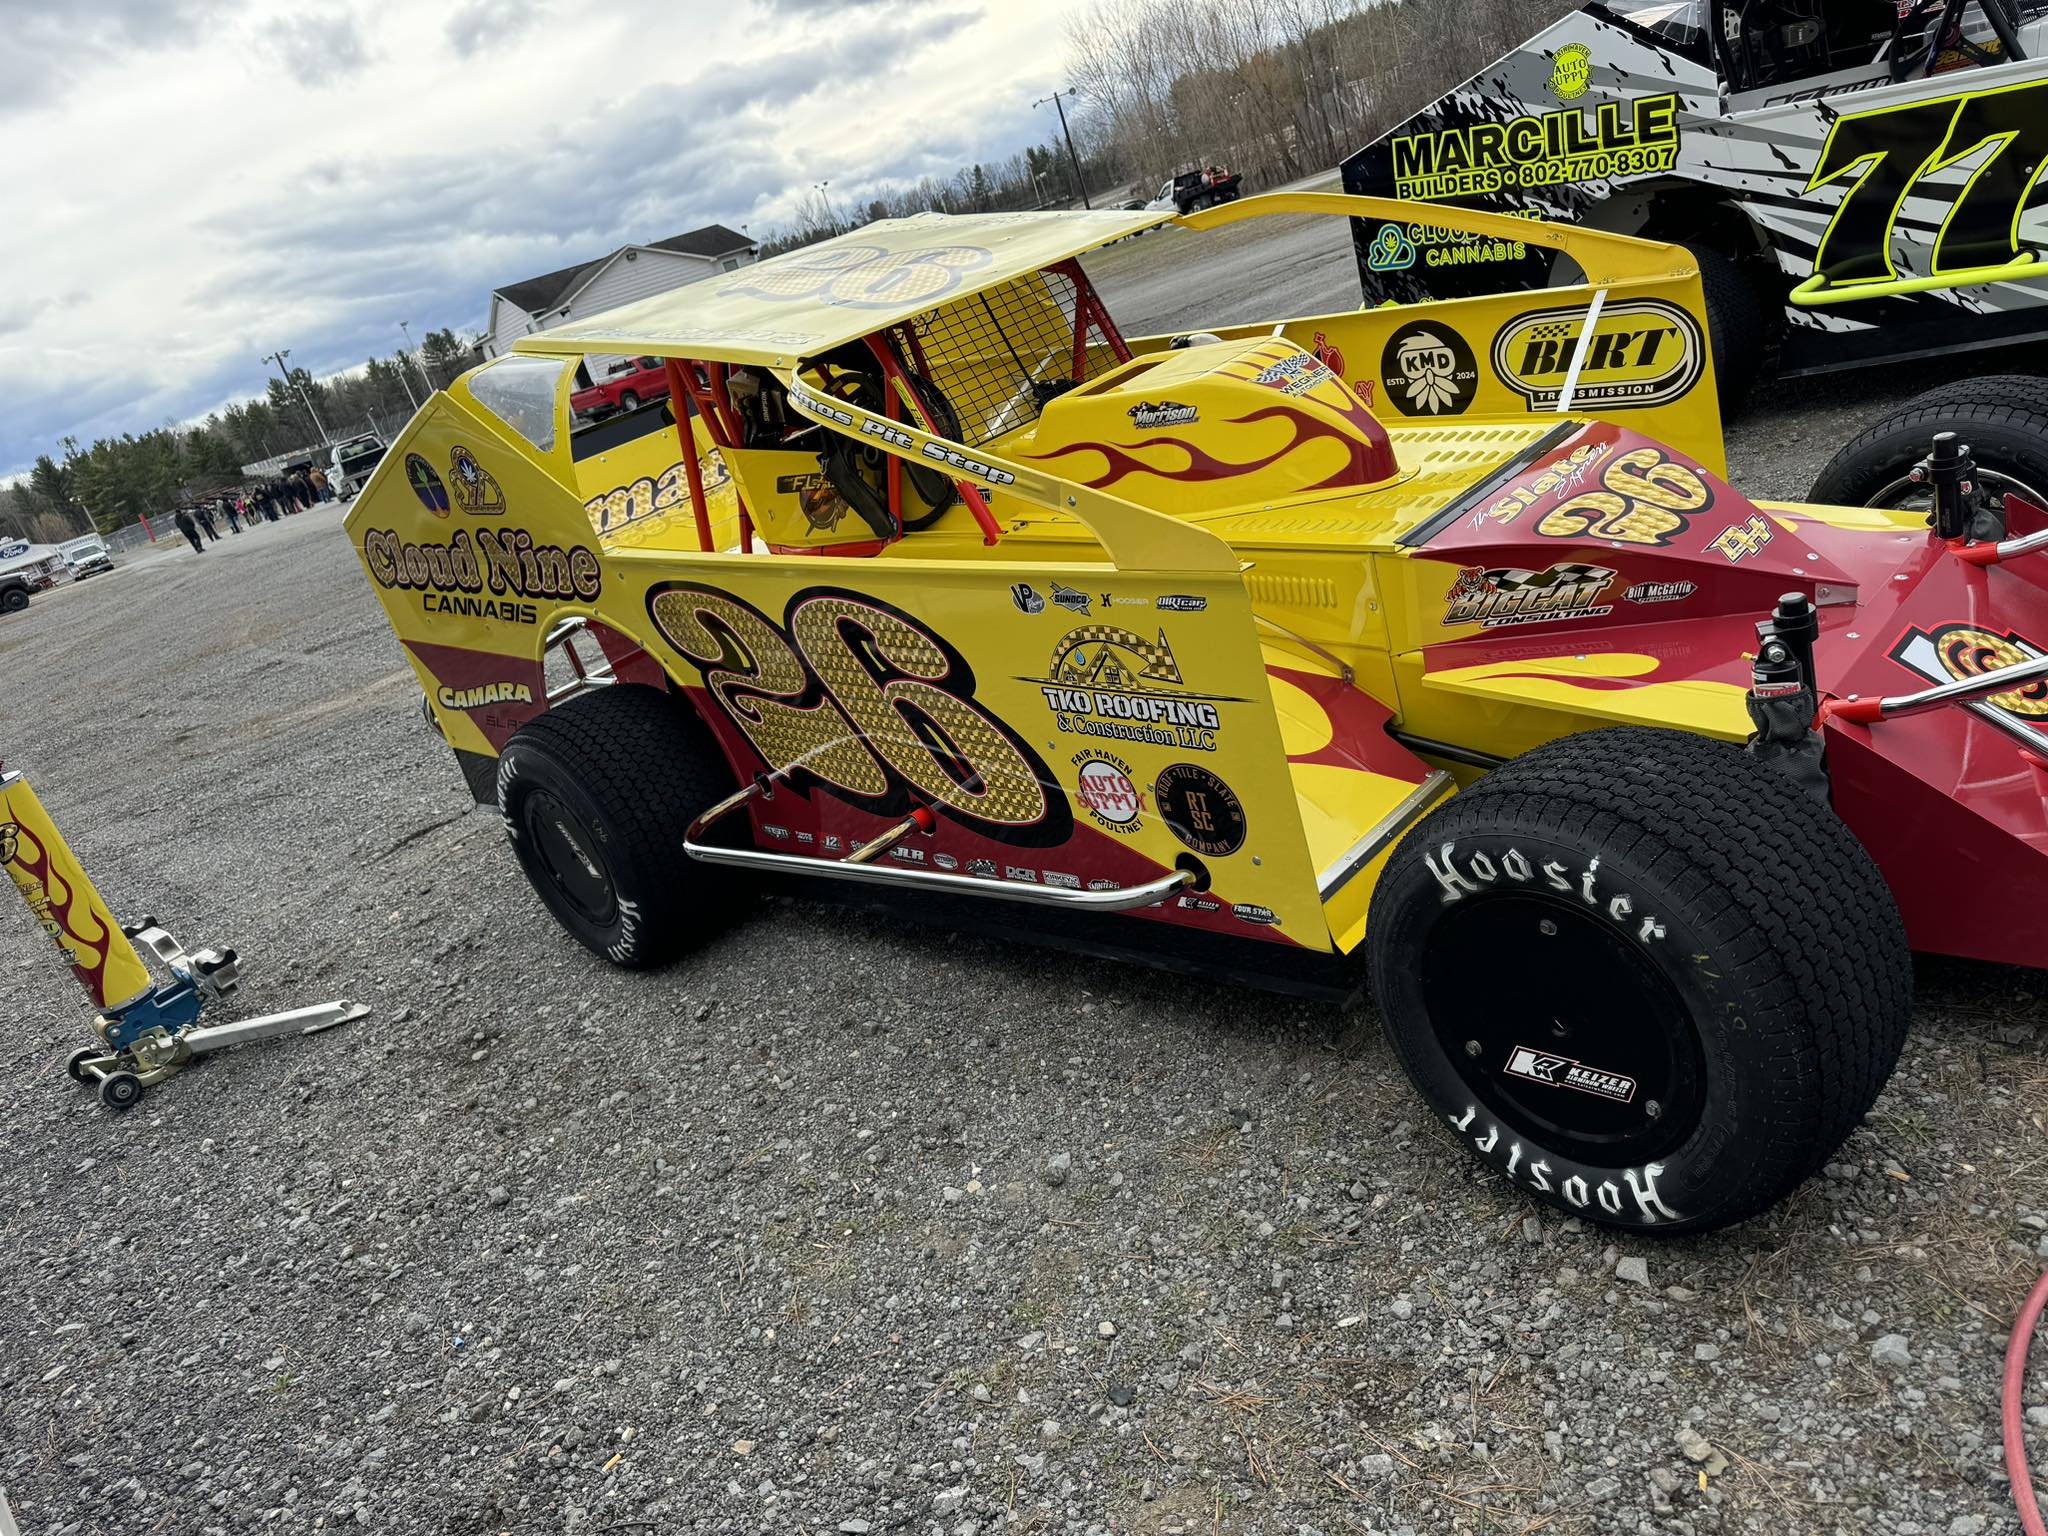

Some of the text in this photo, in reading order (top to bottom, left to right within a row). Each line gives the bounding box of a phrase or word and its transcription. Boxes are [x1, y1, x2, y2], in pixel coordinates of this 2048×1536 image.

[1547, 65, 1594, 89] SUPPLY
[1555, 58, 1587, 76] AUTO
[1392, 92, 1679, 184] MARCILLE
[1396, 144, 1678, 201] BUILDERS 802-770-8307
[1801, 80, 2048, 287] 77
[1426, 241, 1526, 267] CANNABIS
[1404, 350, 1450, 373] KMD
[1517, 327, 1677, 376] BERT
[1280, 365, 1329, 396] WEGNER
[1386, 377, 1406, 386] ESTD
[1455, 371, 1476, 380] 2024
[1538, 384, 1655, 401] TRSMISSION
[1135, 406, 1197, 425] Morrison
[858, 415, 913, 450] Pit
[921, 441, 1016, 486] Stop
[1490, 444, 1595, 526] Slate
[1533, 447, 1715, 547] 26
[3, 545, 24, 559] Ford
[363, 527, 602, 602] Cloud Nine
[1054, 594, 1087, 604] SUNOCO
[1443, 577, 1614, 624] BIGCAT
[1628, 586, 1645, 599] Bill
[1647, 582, 1692, 597] McGaffin
[423, 593, 537, 625] CANNABIS
[1482, 607, 1612, 629] CONSULTING
[438, 681, 534, 711] CAMARA
[1042, 687, 1220, 730] TKO ROOFING
[645, 580, 1074, 848] 26
[1057, 712, 1217, 751] & Construction LLC
[1070, 748, 1133, 775] FAIR HAVEN
[1080, 772, 1134, 793] AUTO
[1158, 767, 1238, 808] ROOF TILE SLATE
[1074, 791, 1148, 812] SUPPLY
[1185, 790, 1206, 812] RT
[1089, 810, 1143, 835] POULTNEY
[1190, 810, 1215, 832] SC
[1184, 833, 1231, 853] COMPANY
[1424, 841, 1666, 943] Hoosier
[1233, 904, 1272, 917] FOUR STAR
[1567, 1067, 1632, 1090] KEIZER
